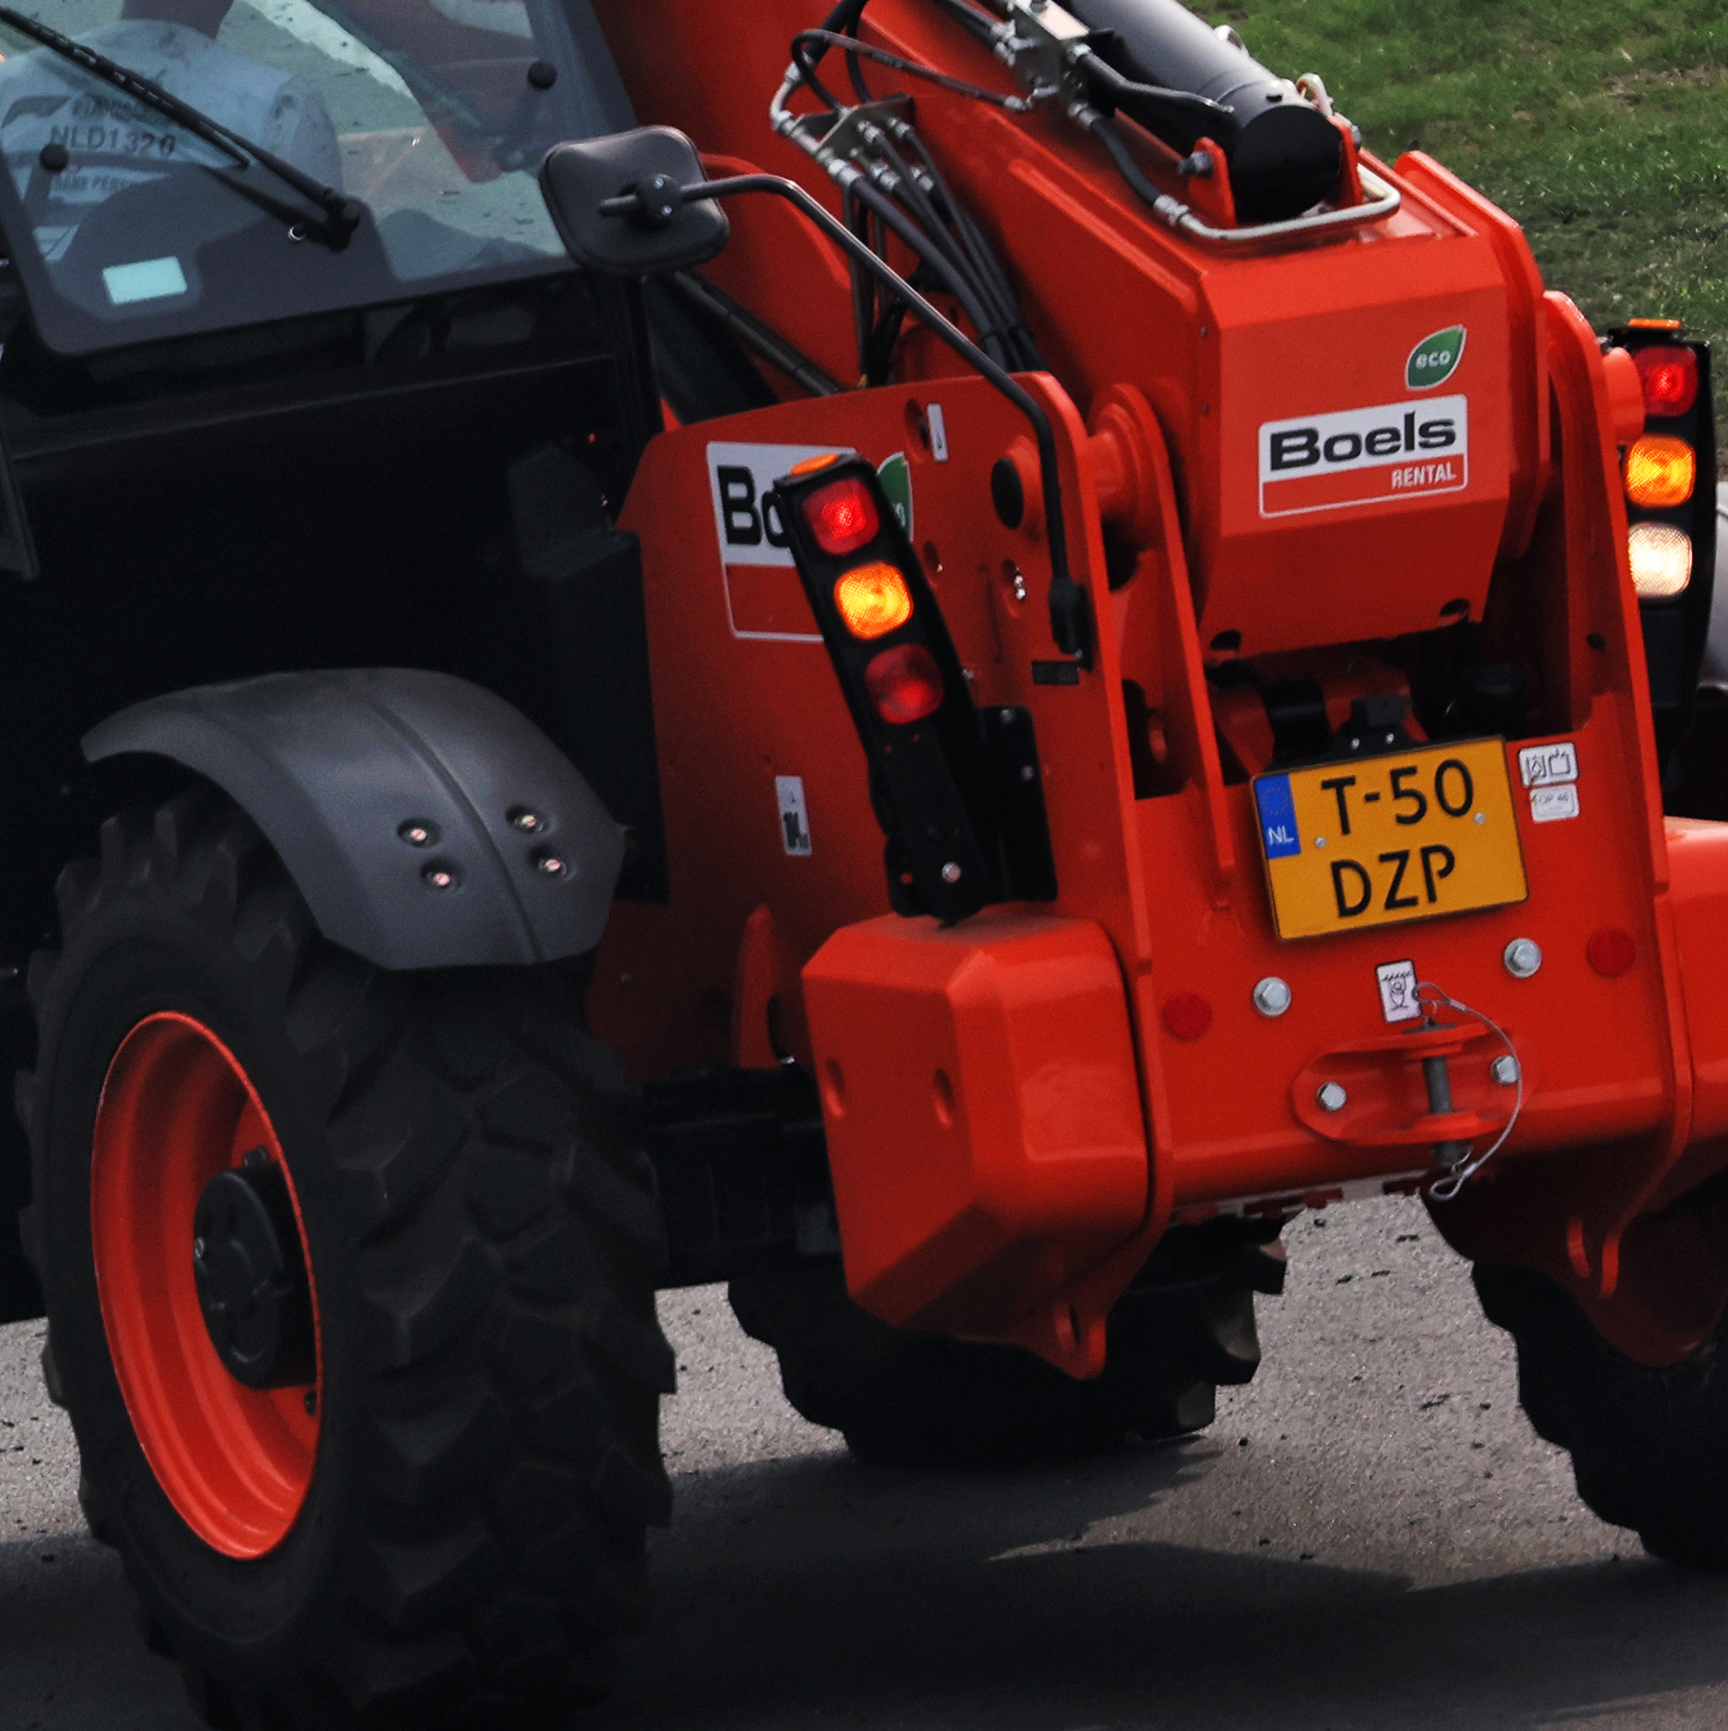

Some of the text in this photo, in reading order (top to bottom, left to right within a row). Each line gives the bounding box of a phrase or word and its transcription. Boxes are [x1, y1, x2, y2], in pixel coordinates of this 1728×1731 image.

[1415, 350, 1451, 369] eco
[1270, 409, 1457, 472] Boels
[717, 464, 791, 549] Bo
[1390, 461, 1458, 490] RENTAL
[1320, 758, 1475, 836] T-50
[1267, 825, 1295, 847] NL
[1330, 843, 1456, 919] DZP
